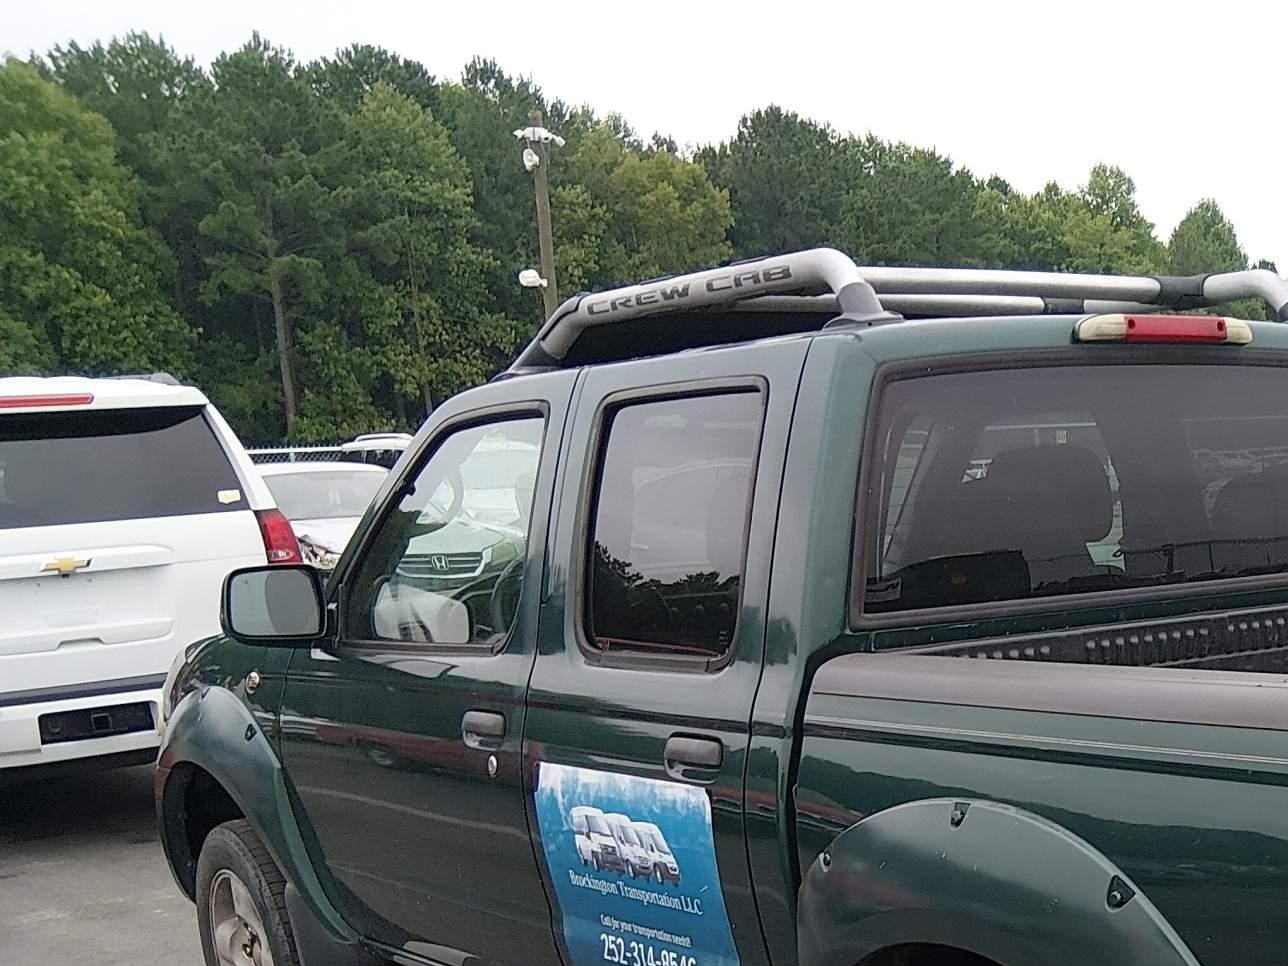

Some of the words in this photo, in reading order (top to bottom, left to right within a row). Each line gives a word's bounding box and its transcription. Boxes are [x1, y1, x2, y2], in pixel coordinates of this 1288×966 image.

[587, 282, 691, 316] CREW
[706, 264, 792, 293] CAB
[568, 869, 618, 895] Brockington
[617, 880, 682, 910] Transportation
[681, 896, 704, 915] LLC
